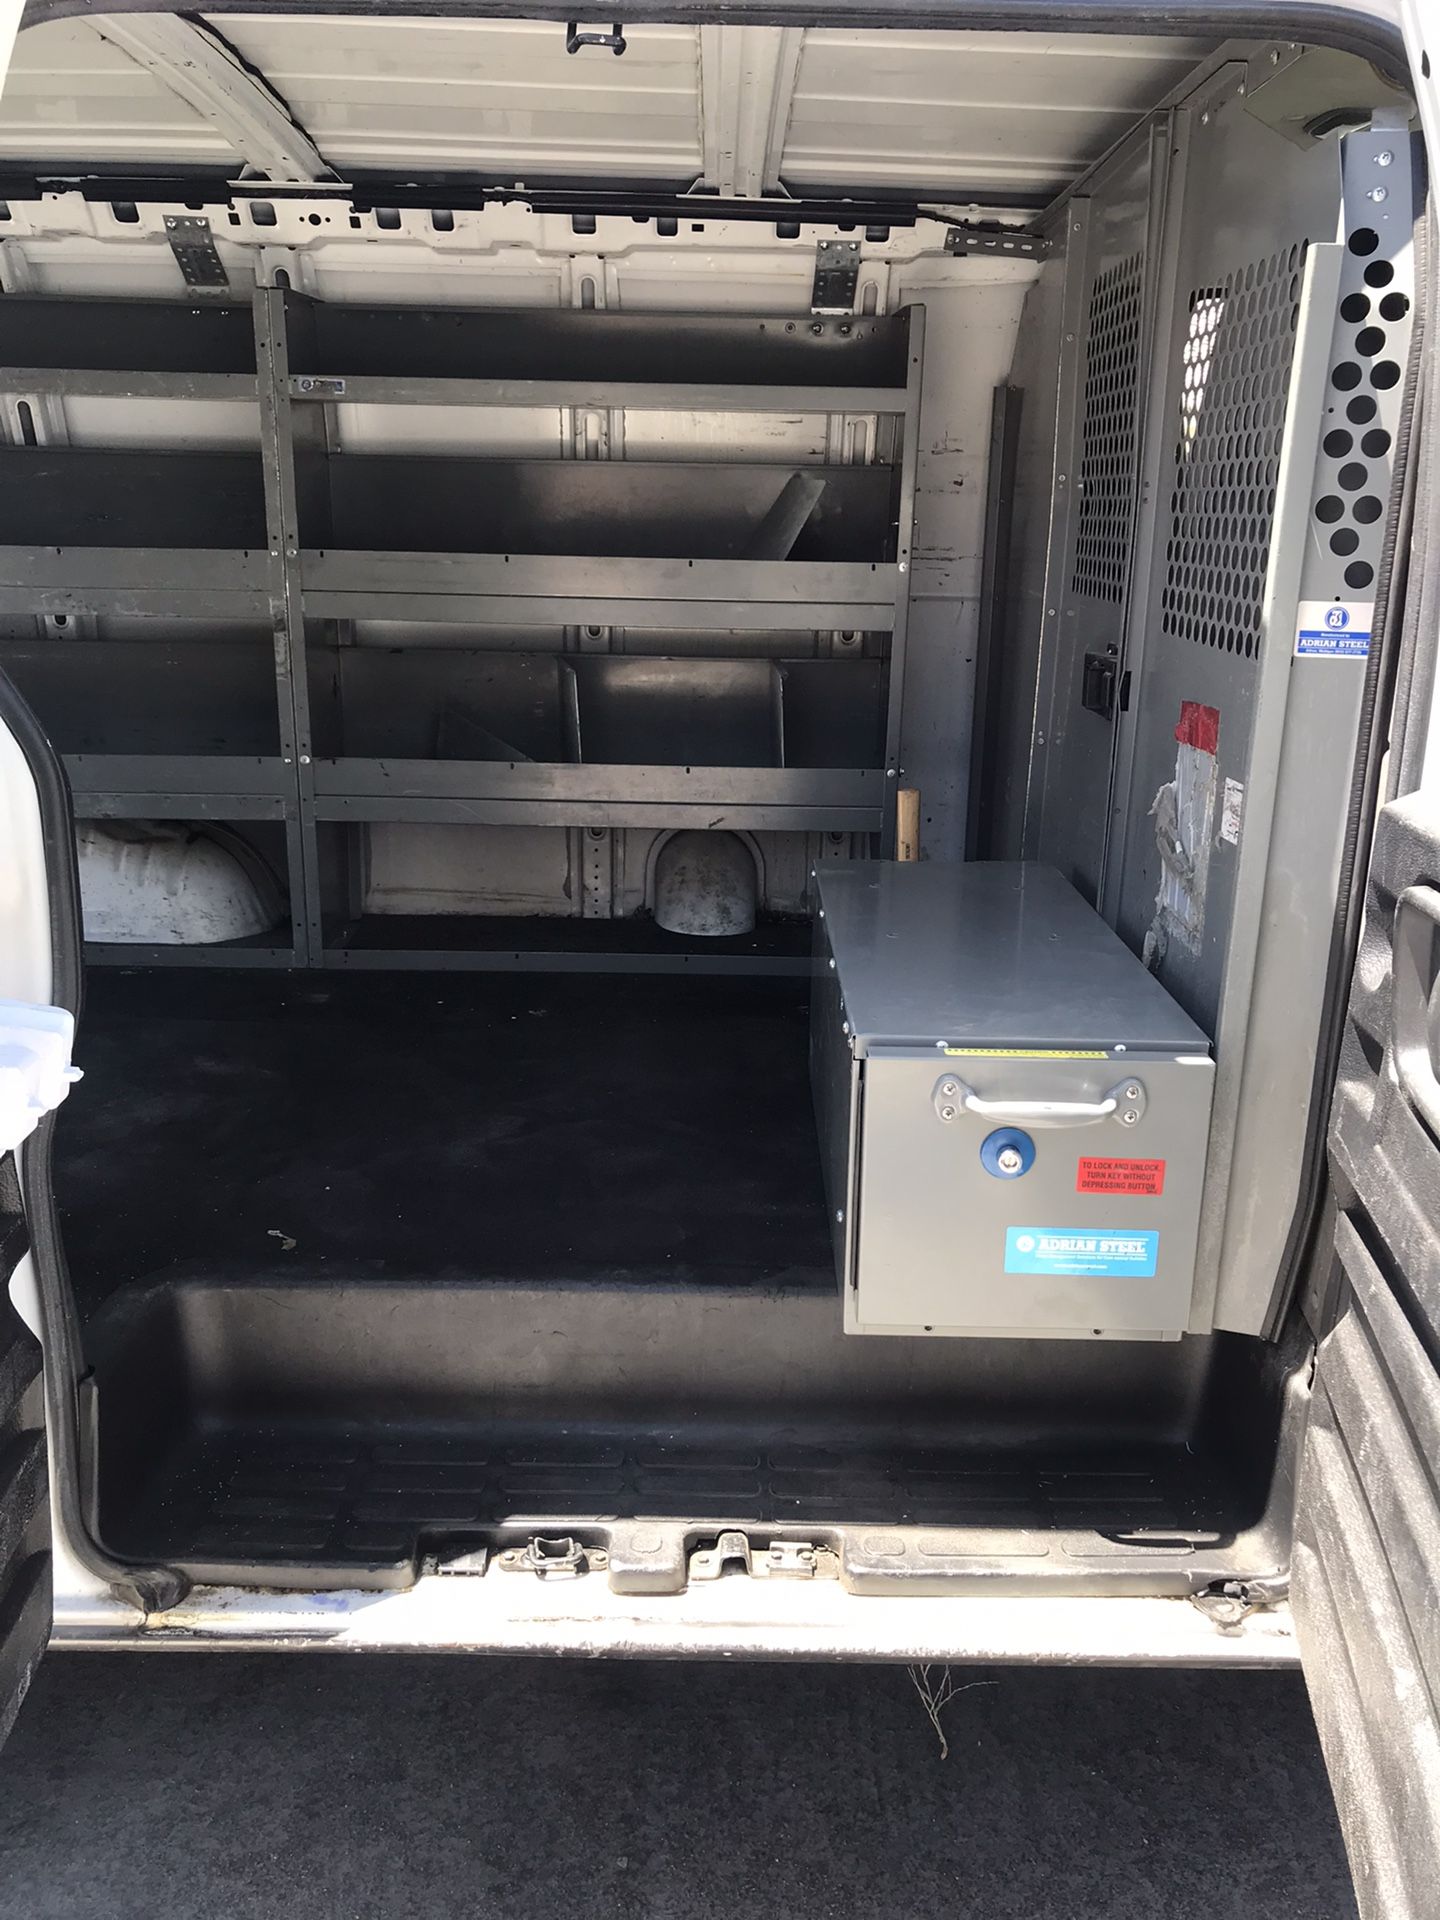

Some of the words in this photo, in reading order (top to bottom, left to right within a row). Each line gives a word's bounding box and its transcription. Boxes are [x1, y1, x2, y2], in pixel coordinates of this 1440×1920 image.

[1300, 639, 1337, 648] ADRIAN
[1338, 639, 1369, 648] STEEL
[1093, 1162, 1112, 1170] LOCK
[1087, 1171, 1106, 1179] TURN
[1107, 1172, 1121, 1180] KEY
[1123, 1173, 1156, 1181] WITHOUT
[1081, 1180, 1126, 1189] DEPRESSING
[1038, 1239, 1096, 1252] ADRIAN
[1100, 1240, 1146, 1253] STEEL
